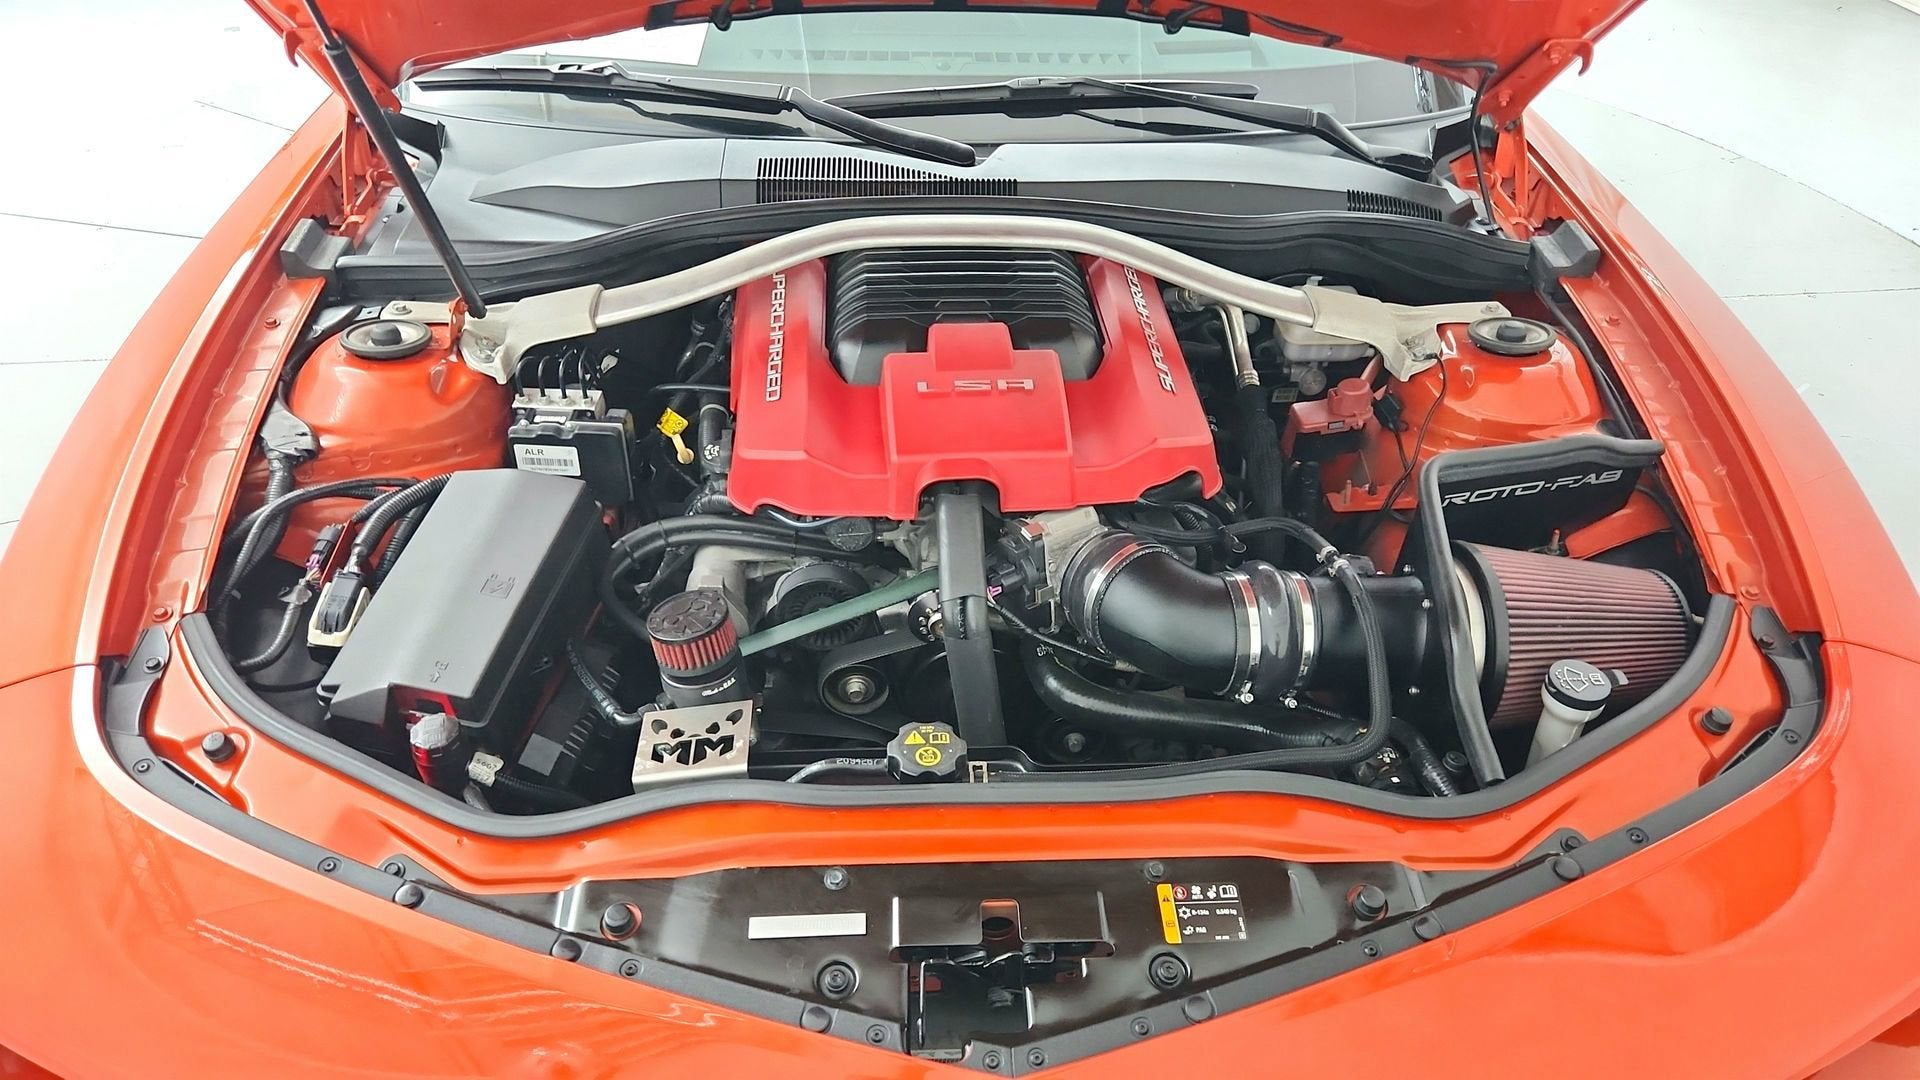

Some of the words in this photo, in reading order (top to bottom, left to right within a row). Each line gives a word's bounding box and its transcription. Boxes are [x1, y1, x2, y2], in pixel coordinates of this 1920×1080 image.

[766, 271, 786, 402] UPERCHARGED
[917, 379, 1034, 393] LSA
[525, 448, 545, 456] ALR
[1442, 469, 1624, 507] ROTO-FAB
